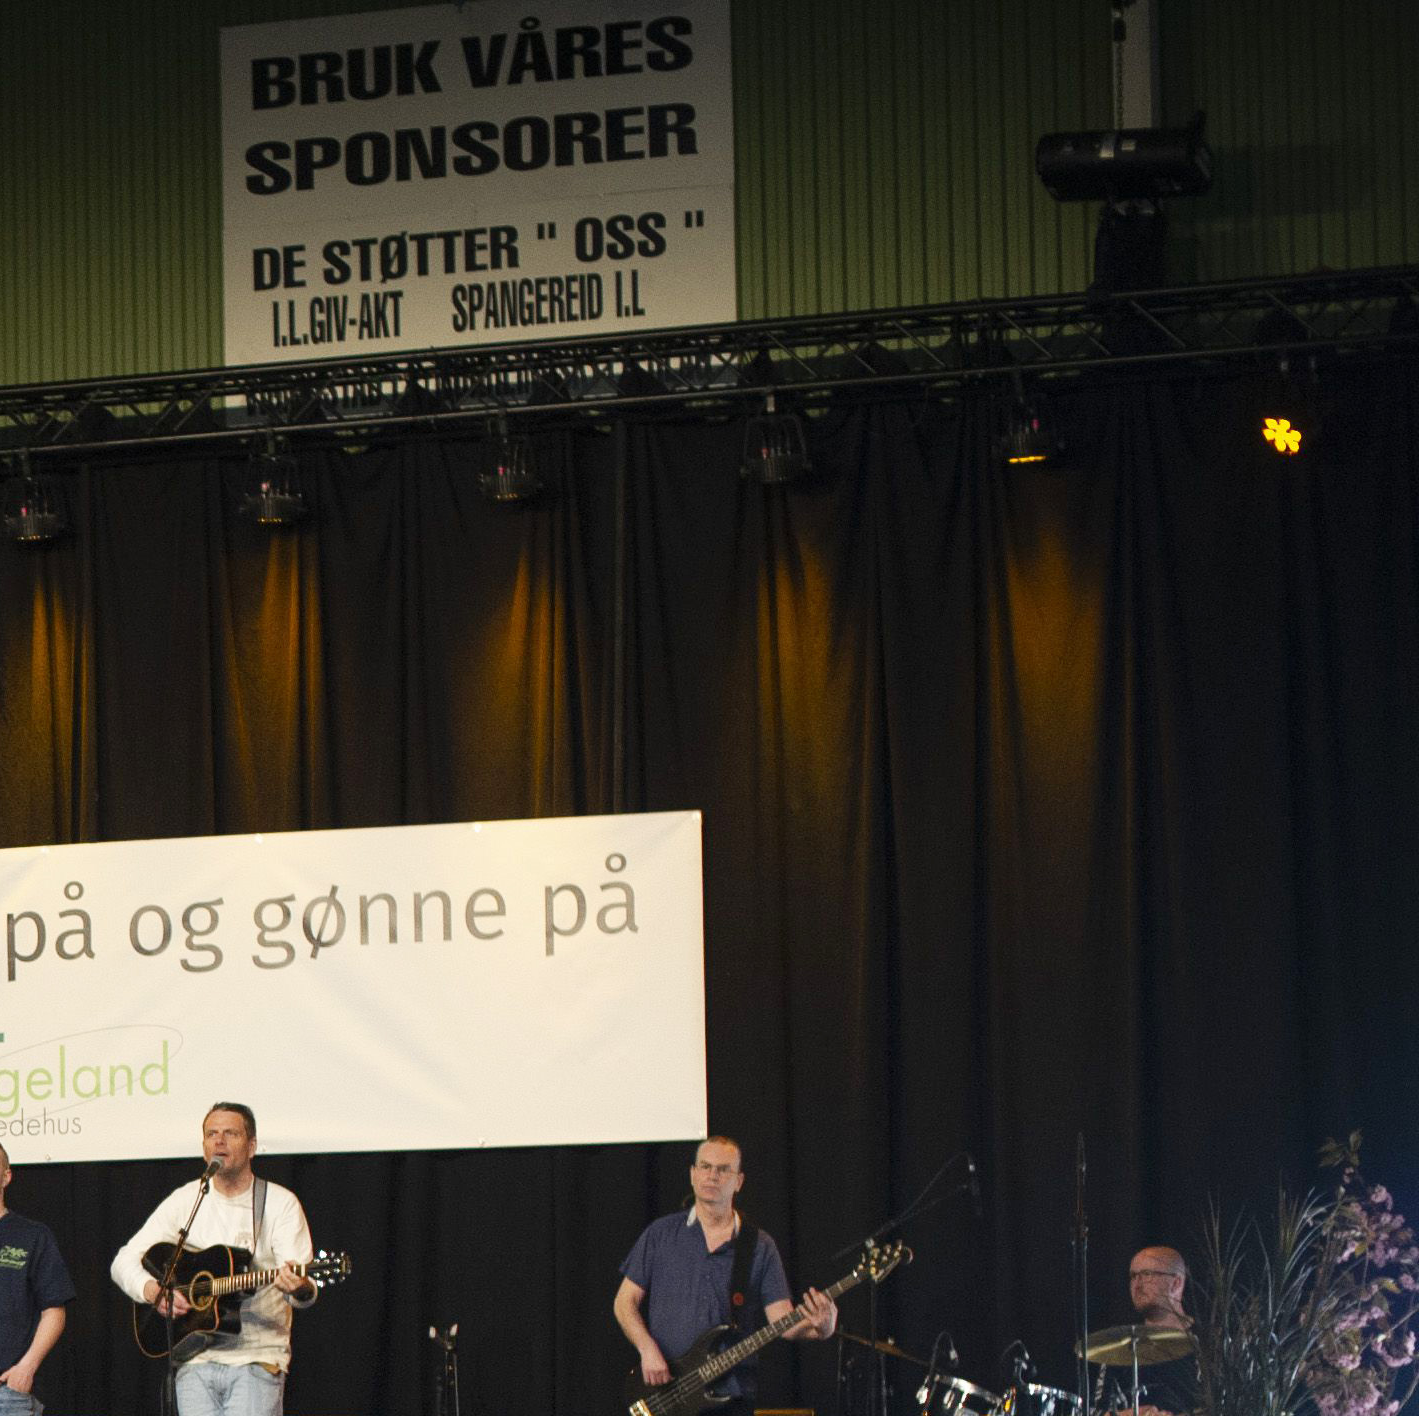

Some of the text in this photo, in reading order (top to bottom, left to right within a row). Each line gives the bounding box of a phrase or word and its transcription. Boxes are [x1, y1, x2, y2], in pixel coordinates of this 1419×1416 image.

[250, 15, 694, 110] BRUK VÅRES
[245, 102, 698, 196] SPONSORER
[253, 245, 306, 291] DE
[323, 223, 520, 285] STØTTER
[574, 211, 666, 263] OSS
[452, 272, 603, 333] SPANGEREID
[7, 881, 96, 981] på
[129, 896, 224, 973] og
[253, 881, 508, 971] gønne
[544, 853, 639, 955] på
